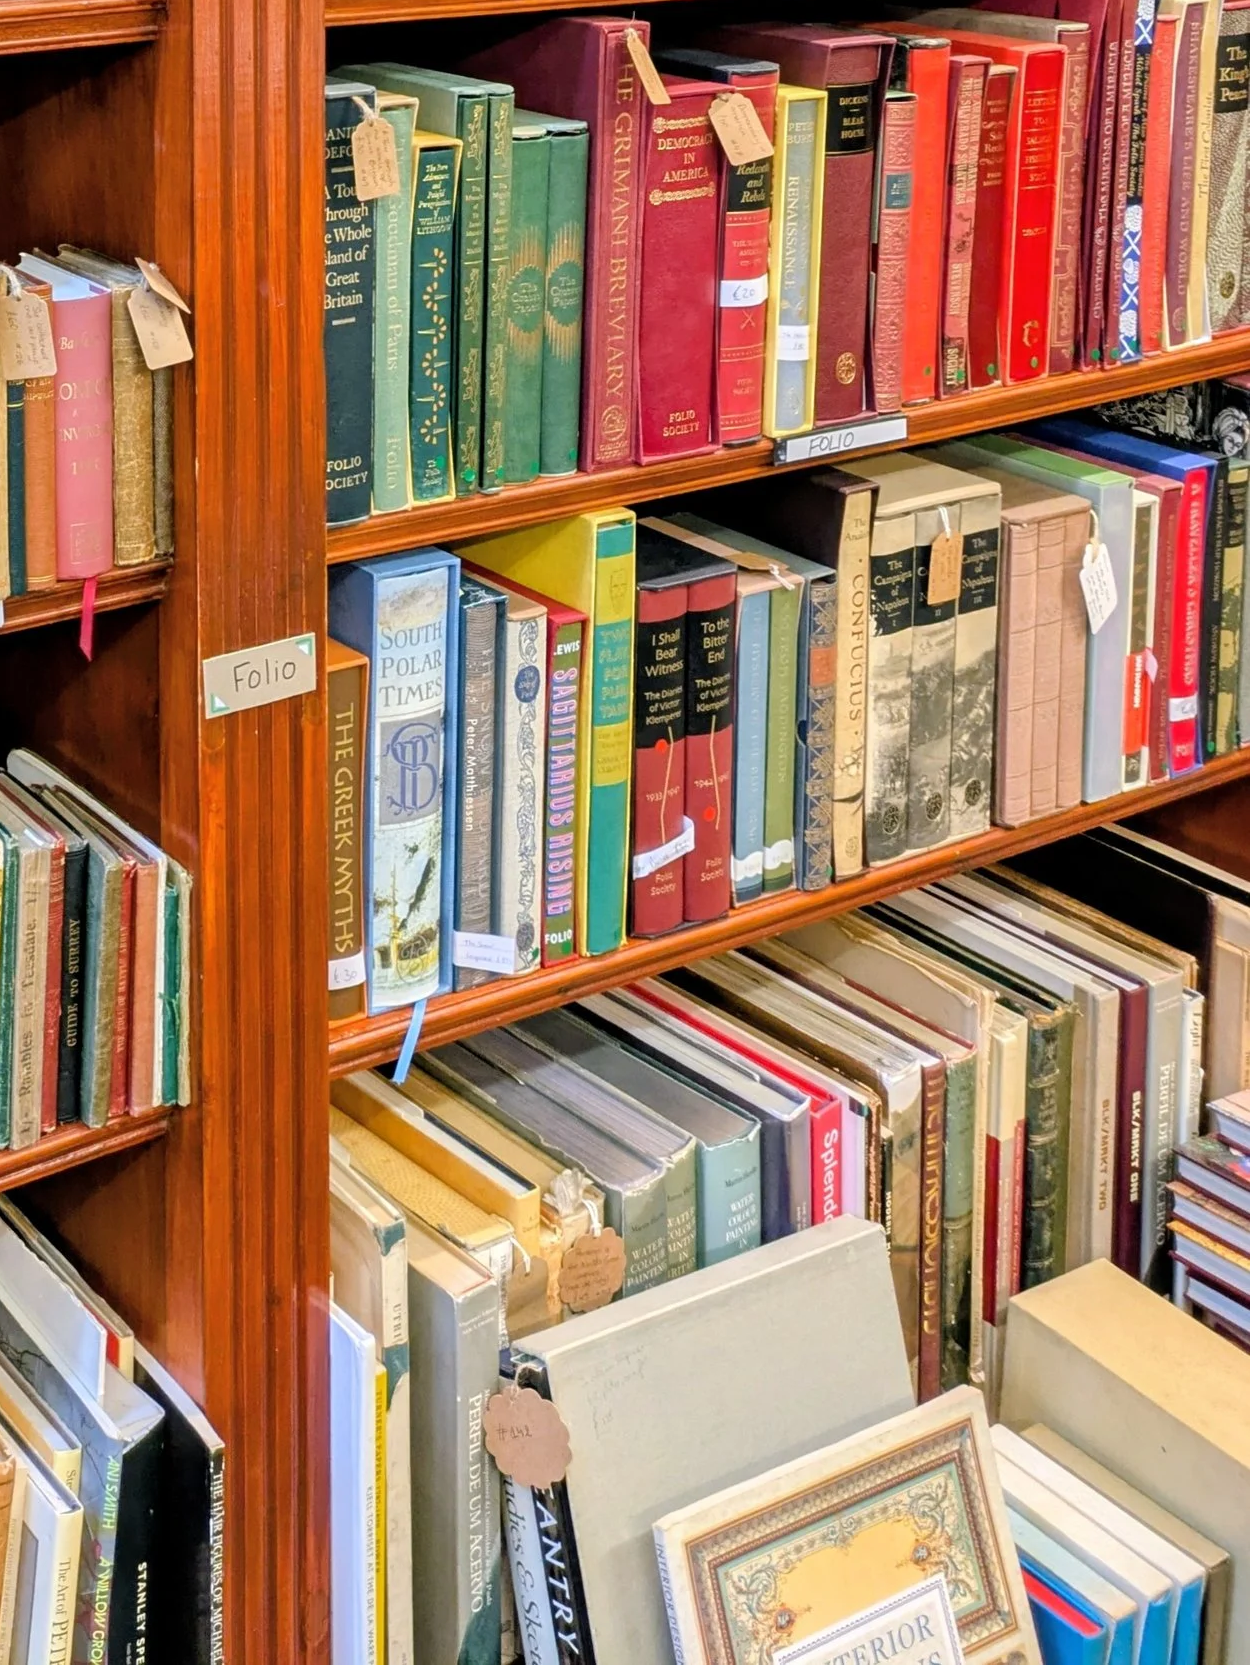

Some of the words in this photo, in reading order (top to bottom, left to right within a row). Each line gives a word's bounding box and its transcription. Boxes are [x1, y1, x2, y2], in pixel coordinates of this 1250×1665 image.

[657, 134, 713, 150] DEMOCRACY
[683, 153, 696, 165] IN
[612, 112, 632, 248] GRIMANI
[663, 165, 709, 183] AMERICA
[745, 178, 763, 190] and
[740, 188, 766, 203] Rebels
[338, 225, 372, 241] Whole
[785, 176, 799, 290] RENAISSANCE
[326, 271, 359, 286] Great
[324, 291, 362, 308] Britain
[733, 284, 756, 301] £20
[607, 256, 629, 398] BREVIARY
[663, 421, 699, 436] SOCIETY
[669, 410, 696, 424] FOLIO
[808, 431, 855, 452] FOLIO
[327, 457, 361, 470] FOLIO
[972, 538, 987, 549] The
[887, 560, 903, 571] The
[379, 623, 443, 652] SOUTH
[652, 633, 656, 647] I
[659, 628, 681, 645] Shall
[703, 633, 729, 648] Bitter
[848, 573, 864, 727] CONFUCIUS
[379, 649, 443, 678] POLAR
[656, 645, 678, 660] Bear
[707, 648, 725, 663] End
[234, 657, 297, 693] Folio
[645, 659, 684, 678] Witness
[379, 678, 443, 708] TIMES
[336, 704, 353, 762] THE
[466, 718, 477, 750] Peter
[551, 666, 577, 828] SAGITTARIUS
[465, 754, 477, 832] Matthiessen
[334, 767, 353, 851] GREEK
[547, 833, 575, 916] RISING
[333, 856, 354, 953] MYTHS
[69, 918, 80, 973] SURREY
[545, 928, 572, 945] FOLIO
[70, 978, 79, 999] TO
[66, 1004, 78, 1048] GUIDE
[468, 1393, 482, 1460] PERFIL
[468, 1463, 481, 1492] DE
[468, 1494, 482, 1529] UM
[469, 1534, 484, 1614] ACERVO
[136, 1561, 148, 1632] STANLEY
